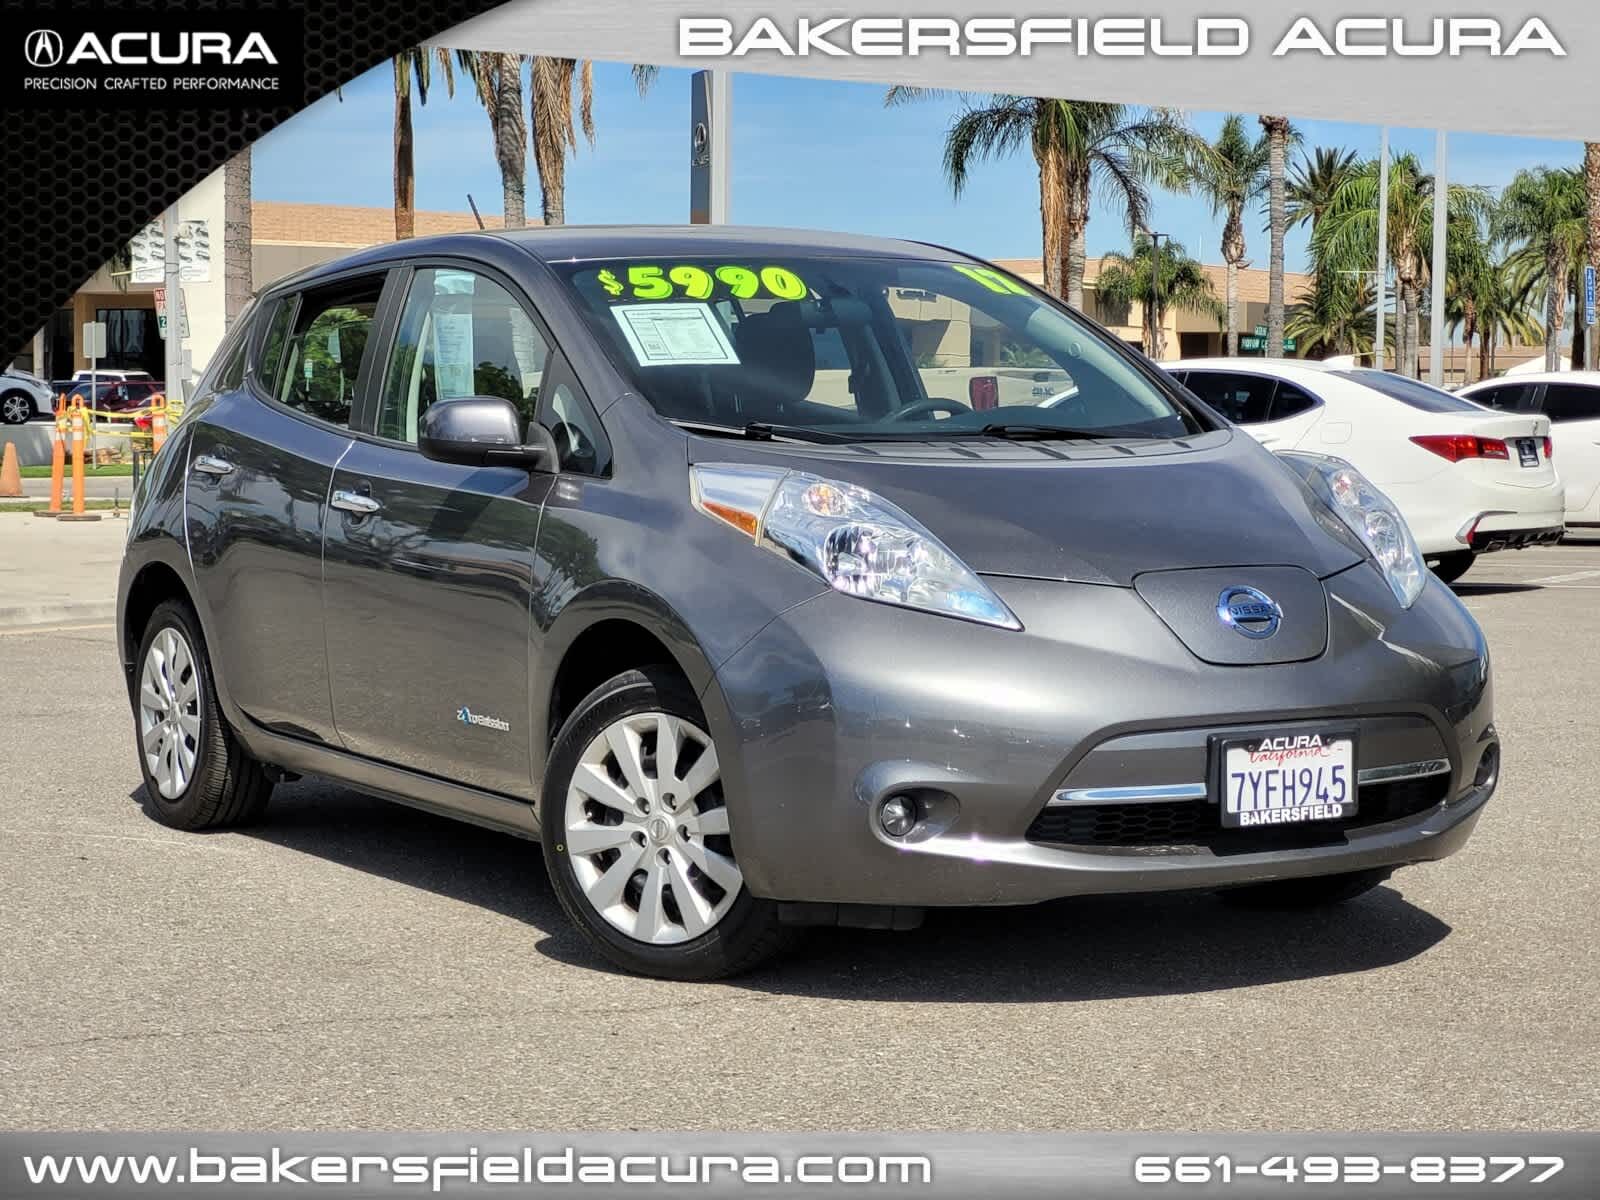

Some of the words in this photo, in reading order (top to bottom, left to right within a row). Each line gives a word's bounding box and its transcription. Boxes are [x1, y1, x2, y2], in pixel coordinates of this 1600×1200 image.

[597, 265, 808, 300] $5990
[1259, 734, 1322, 752] ACURA
[1231, 764, 1346, 812] 7YFH945
[1240, 803, 1343, 826] BAKERSFIELD
